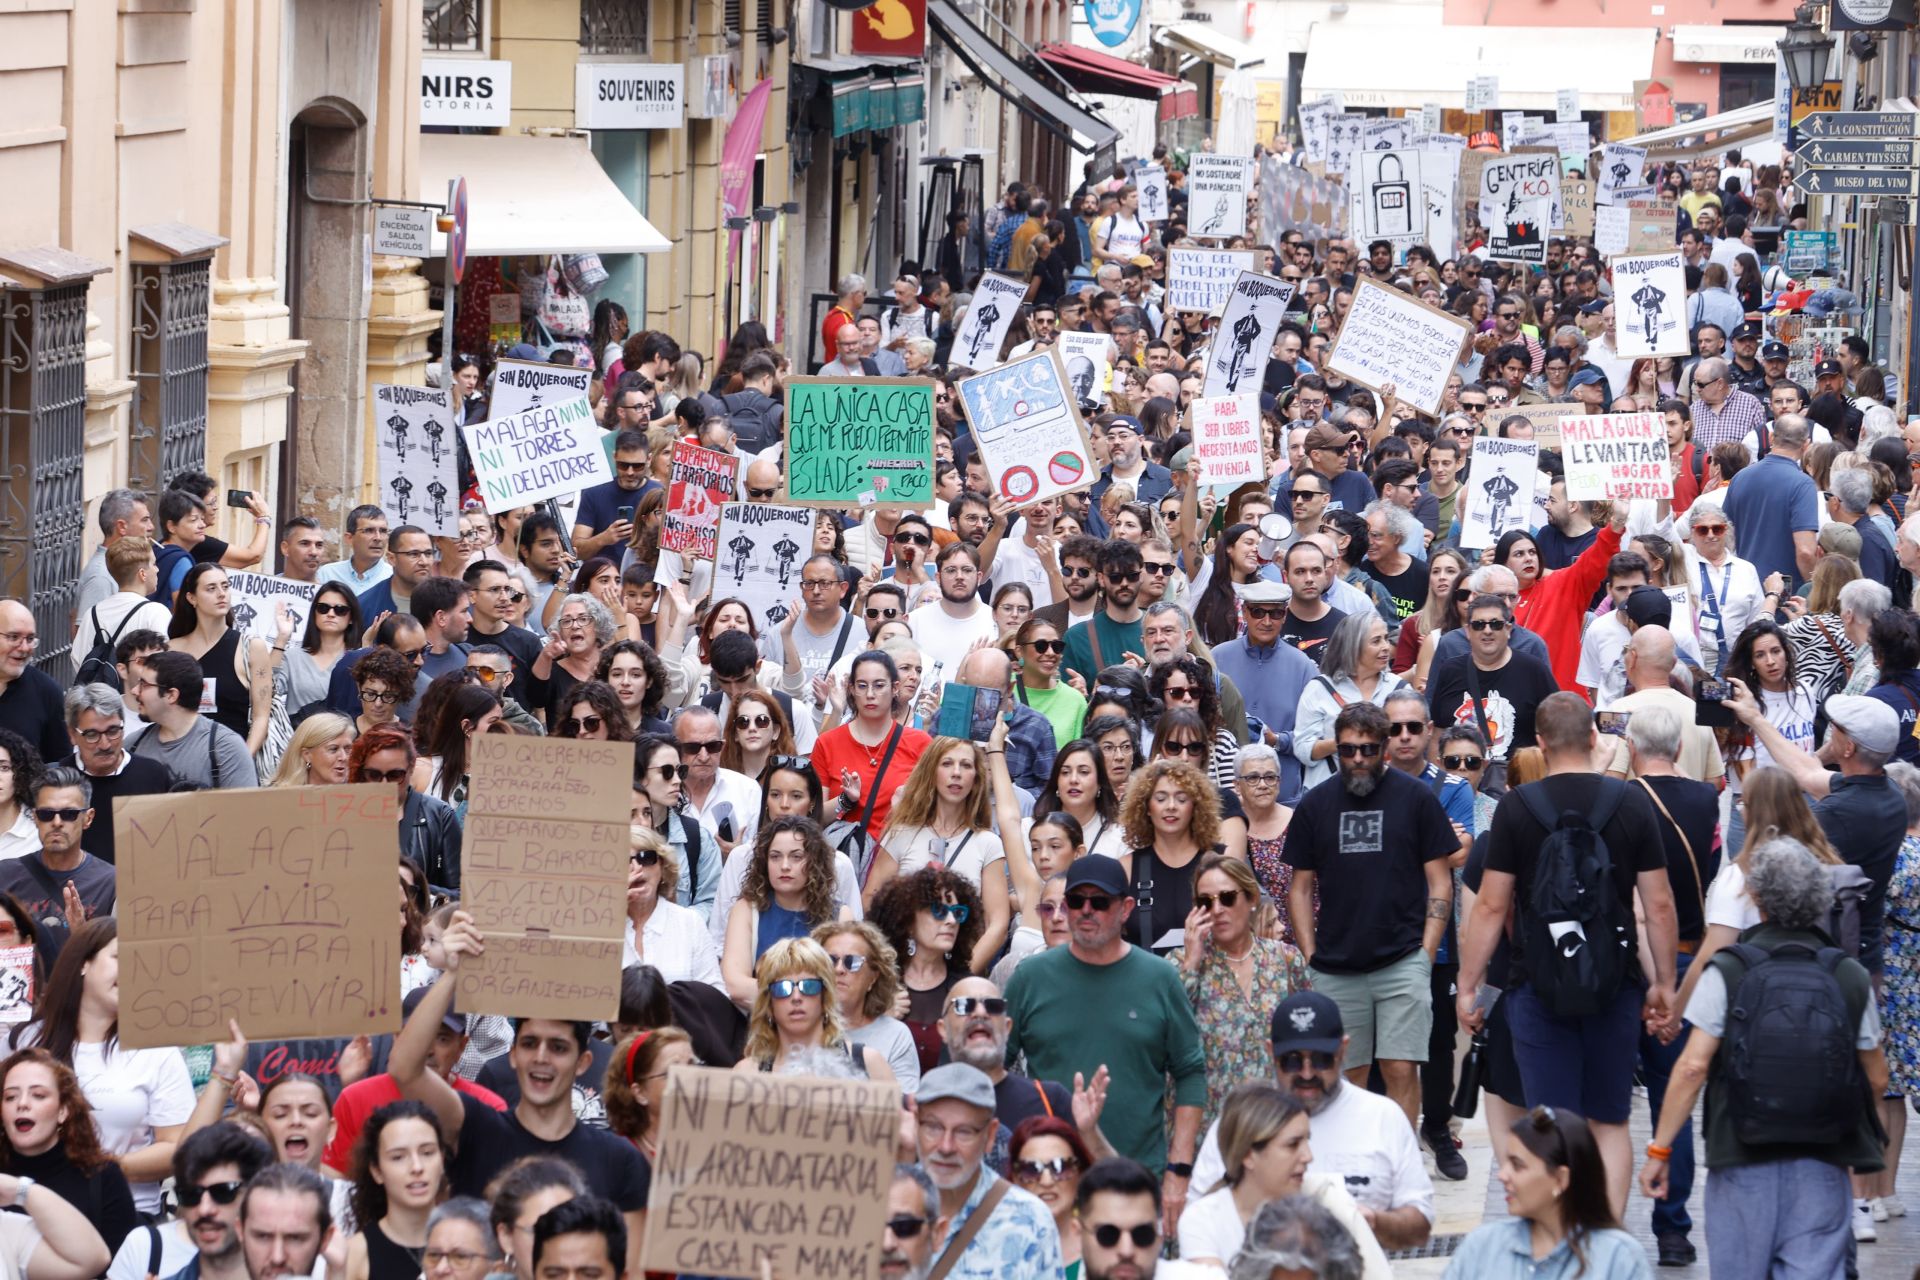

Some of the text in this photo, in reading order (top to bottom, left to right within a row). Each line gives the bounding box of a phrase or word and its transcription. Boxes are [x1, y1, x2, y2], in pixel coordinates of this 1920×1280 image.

[422, 75, 493, 99] NIRS
[599, 79, 675, 101] SOUVENIRS
[424, 100, 493, 110] CTORIA
[636, 103, 675, 112] VICTORIA
[1829, 121, 1911, 135] LA CONSTITUCIÓN
[1880, 115, 1911, 123] PLAZA DE
[1824, 152, 1909, 163] CARMEN THYSSEN
[1884, 144, 1910, 152] MUSEO
[1196, 157, 1203, 165] LA
[1232, 158, 1243, 168] VEZ
[1196, 170, 1204, 178] NO
[1834, 177, 1908, 188] MUSEO DEL VINO
[1195, 183, 1242, 192] UNA PANCARTA
[380, 221, 424, 231] ENCENDIDA
[395, 213, 410, 221] LUZ
[380, 240, 423, 251] VEHÍCULOS
[388, 231, 415, 240] SALIDA
[1172, 253, 1233, 264] VIVO DEL
[1615, 255, 1680, 275] SIN BOQUERONES
[1180, 265, 1239, 278] TURISMO
[1237, 279, 1292, 303] SIN BOQUERONES
[1363, 285, 1388, 302] OJO:
[499, 369, 587, 391] SIN BOQUERONES
[378, 387, 447, 407] SIN BOQUERONES
[791, 388, 815, 425] LA
[885, 391, 930, 426] CASA
[1214, 402, 1237, 416] PARA
[476, 409, 559, 449] MÁLAGA
[1205, 420, 1250, 437] SER LIBRES
[790, 423, 818, 455] QUE
[820, 423, 838, 450] ME
[842, 423, 877, 452] PUEDO
[1200, 440, 1258, 458] NECESITAMOS
[1475, 440, 1537, 458] SIN BOQUERONES
[479, 428, 578, 472] NI TORRES
[673, 443, 720, 473] CUERPOS
[866, 459, 927, 470] MINECRAFT
[1208, 460, 1252, 477] VIVIENDA
[1611, 463, 1662, 479] HOGAR
[486, 475, 513, 502] NI
[901, 473, 928, 488] PACO
[1605, 481, 1670, 499] LIBERTAD
[724, 504, 810, 526] SIN BOQUERONES
[228, 573, 315, 602] SIN BOQUERONES
[476, 739, 617, 766] NO QUEREMOS
[478, 762, 583, 782] IRNOS AL
[471, 794, 567, 814] QUEREMOS
[470, 818, 621, 844] QUEDARNOS EN
[129, 813, 355, 885] MÁLAGA
[468, 838, 621, 873] EL BARRIO.
[468, 879, 613, 906] VIVIENDA
[129, 893, 212, 936] PARA
[485, 937, 621, 960] SOBEDIENCIA
[132, 934, 352, 984] NO PARA
[257, 1046, 340, 1084] Comi
[672, 1074, 895, 1154] NI PROPIETARIA
[657, 1140, 690, 1185] NI
[665, 1192, 856, 1237] ESTANCADA EN
[676, 1238, 875, 1280] CASA DE MAMÁ
